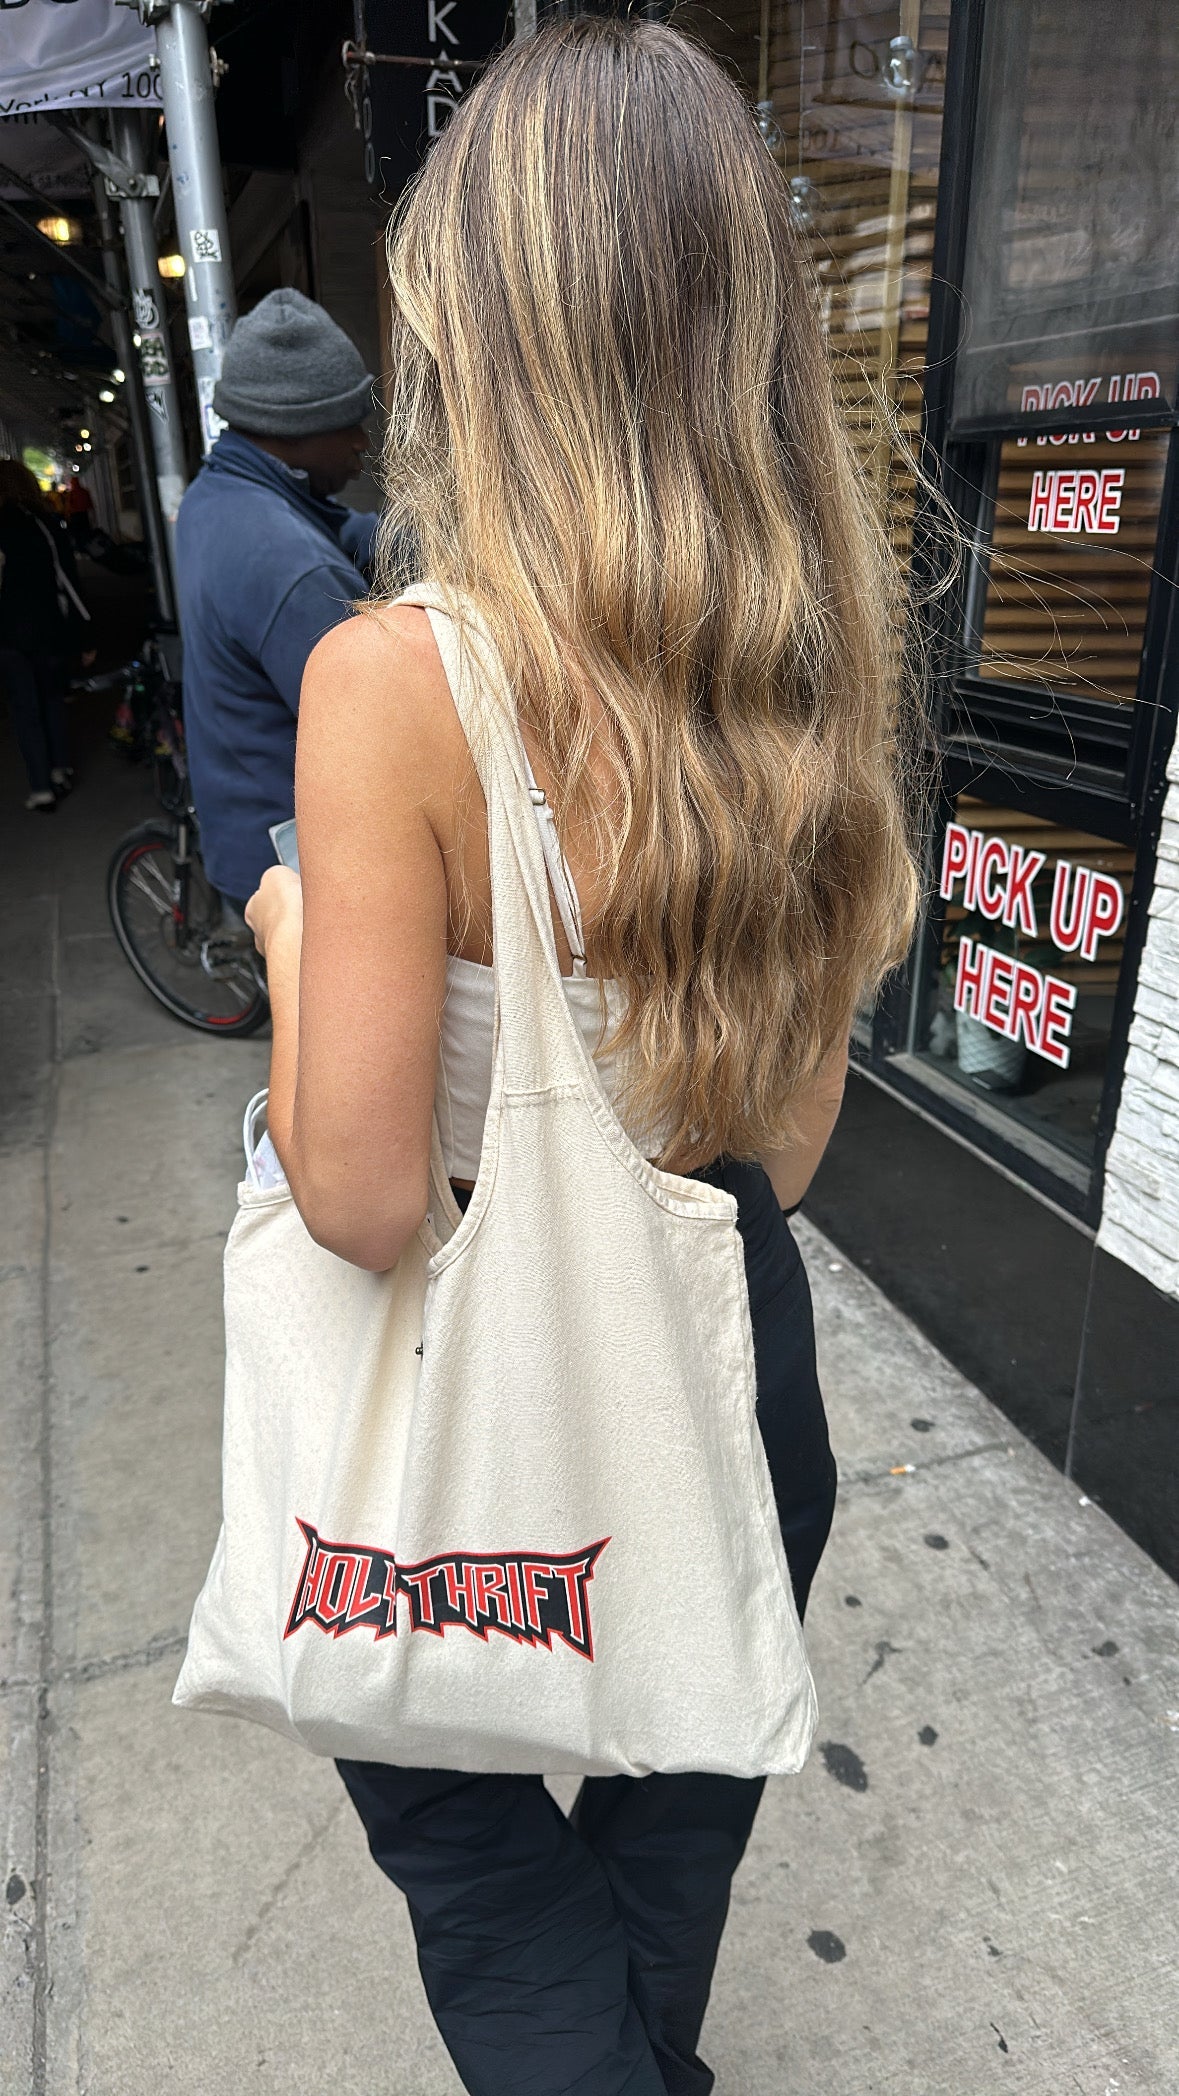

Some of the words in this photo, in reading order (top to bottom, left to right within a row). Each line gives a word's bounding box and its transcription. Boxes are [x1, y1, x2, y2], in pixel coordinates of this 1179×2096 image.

[1027, 468, 1126, 534] HERE
[939, 821, 1047, 938] PICK
[1050, 859, 1124, 961] UP
[953, 936, 1078, 1070] HERE
[400, 1550, 595, 1650] THRIFT
